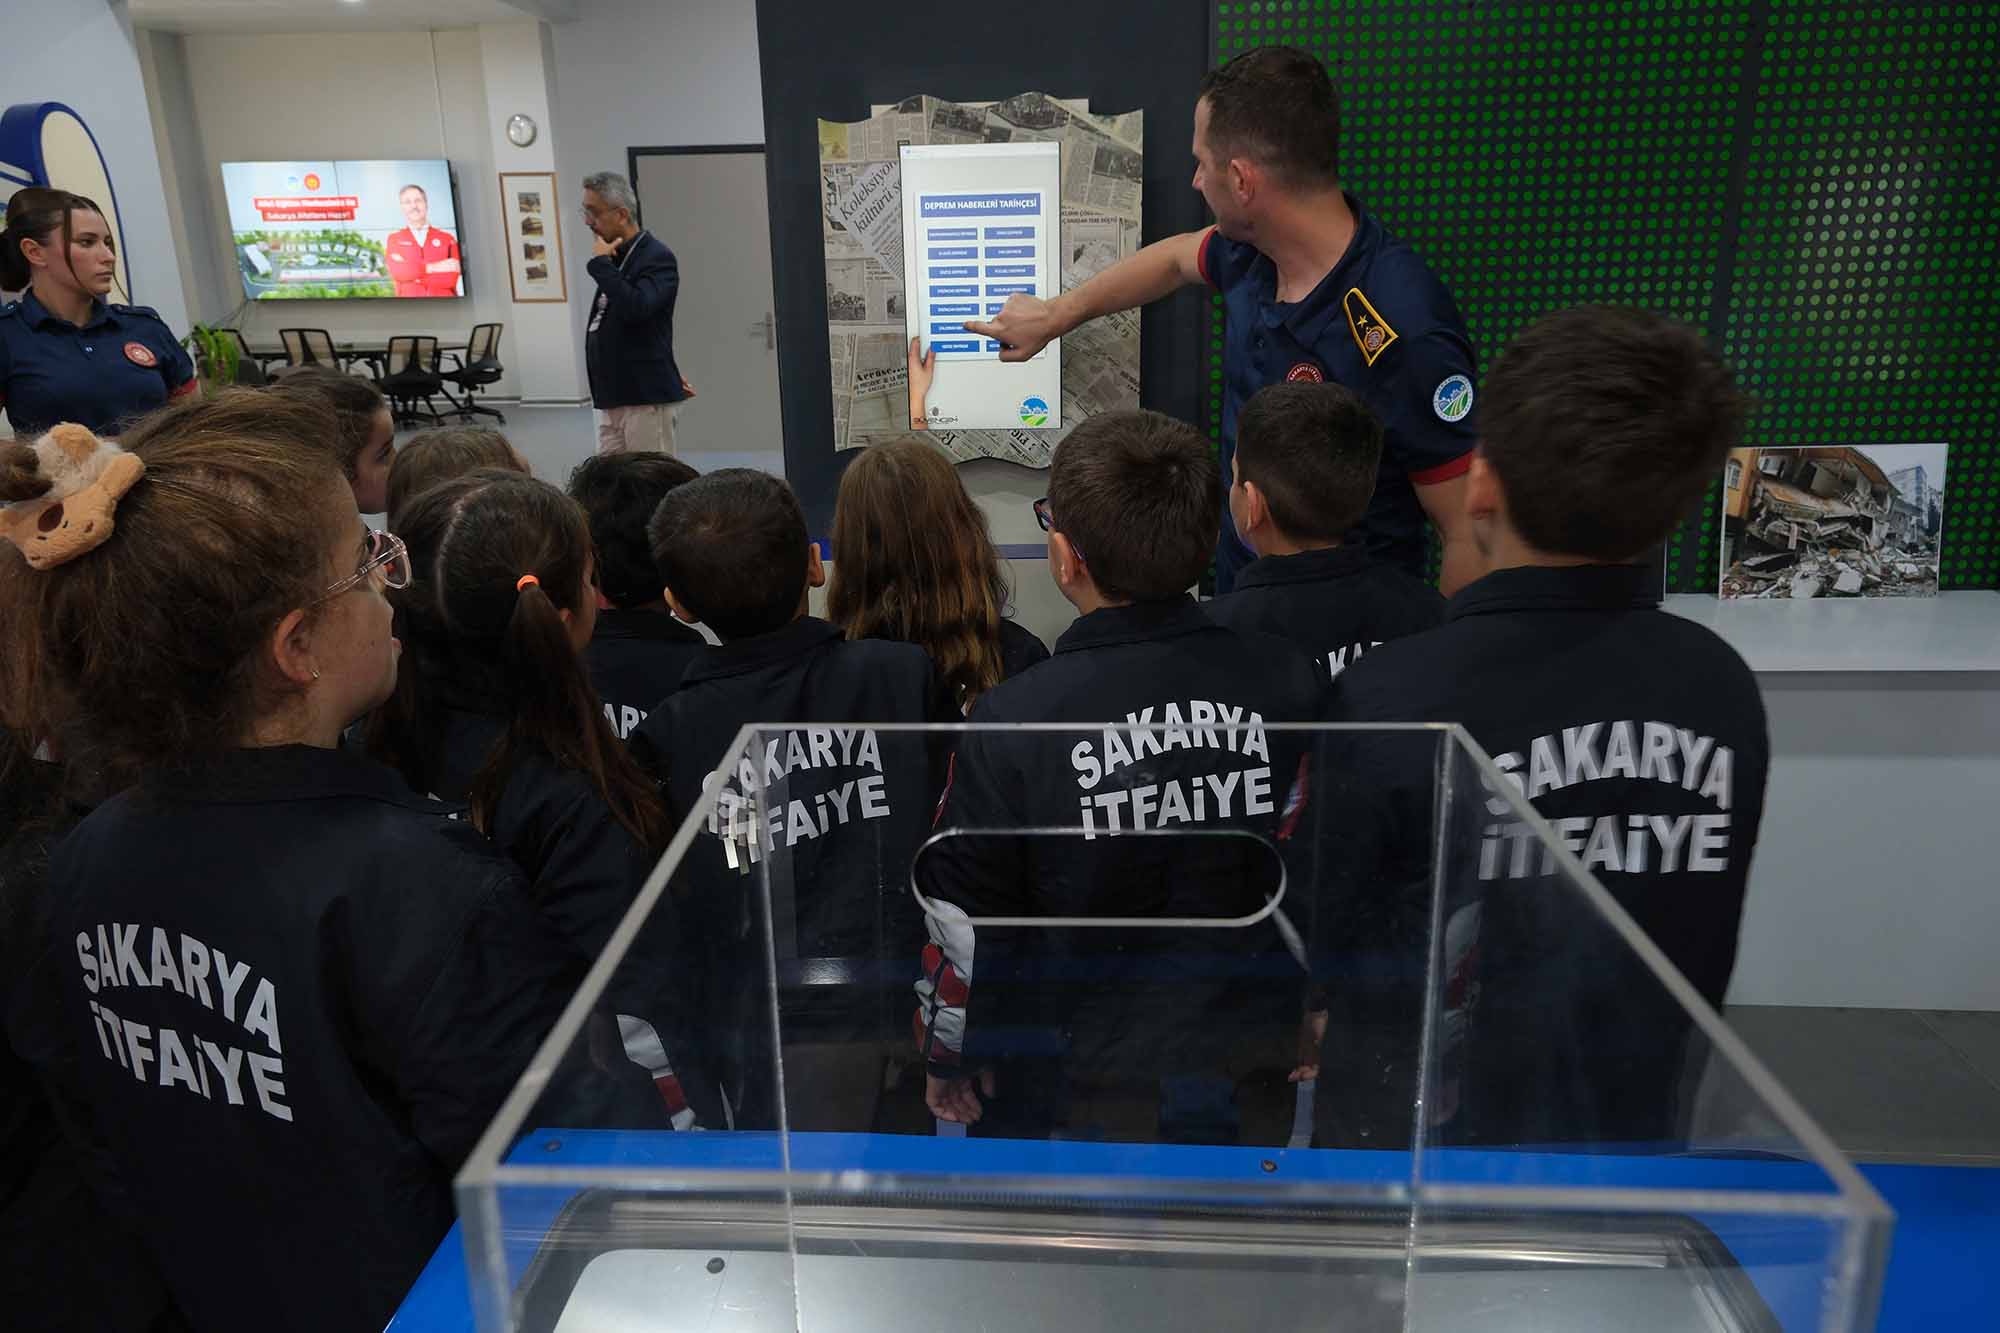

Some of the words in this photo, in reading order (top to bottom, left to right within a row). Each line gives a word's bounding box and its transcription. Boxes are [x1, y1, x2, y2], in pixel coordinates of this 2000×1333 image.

[924, 201, 957, 210] DEPREM
[958, 199, 998, 209] HABERLERİ
[1071, 699, 1270, 790] SAKARYA
[1079, 766, 1275, 841] İTFAİYE
[75, 922, 283, 1055] SAKARYA
[88, 999, 295, 1123] İTFAİYE
